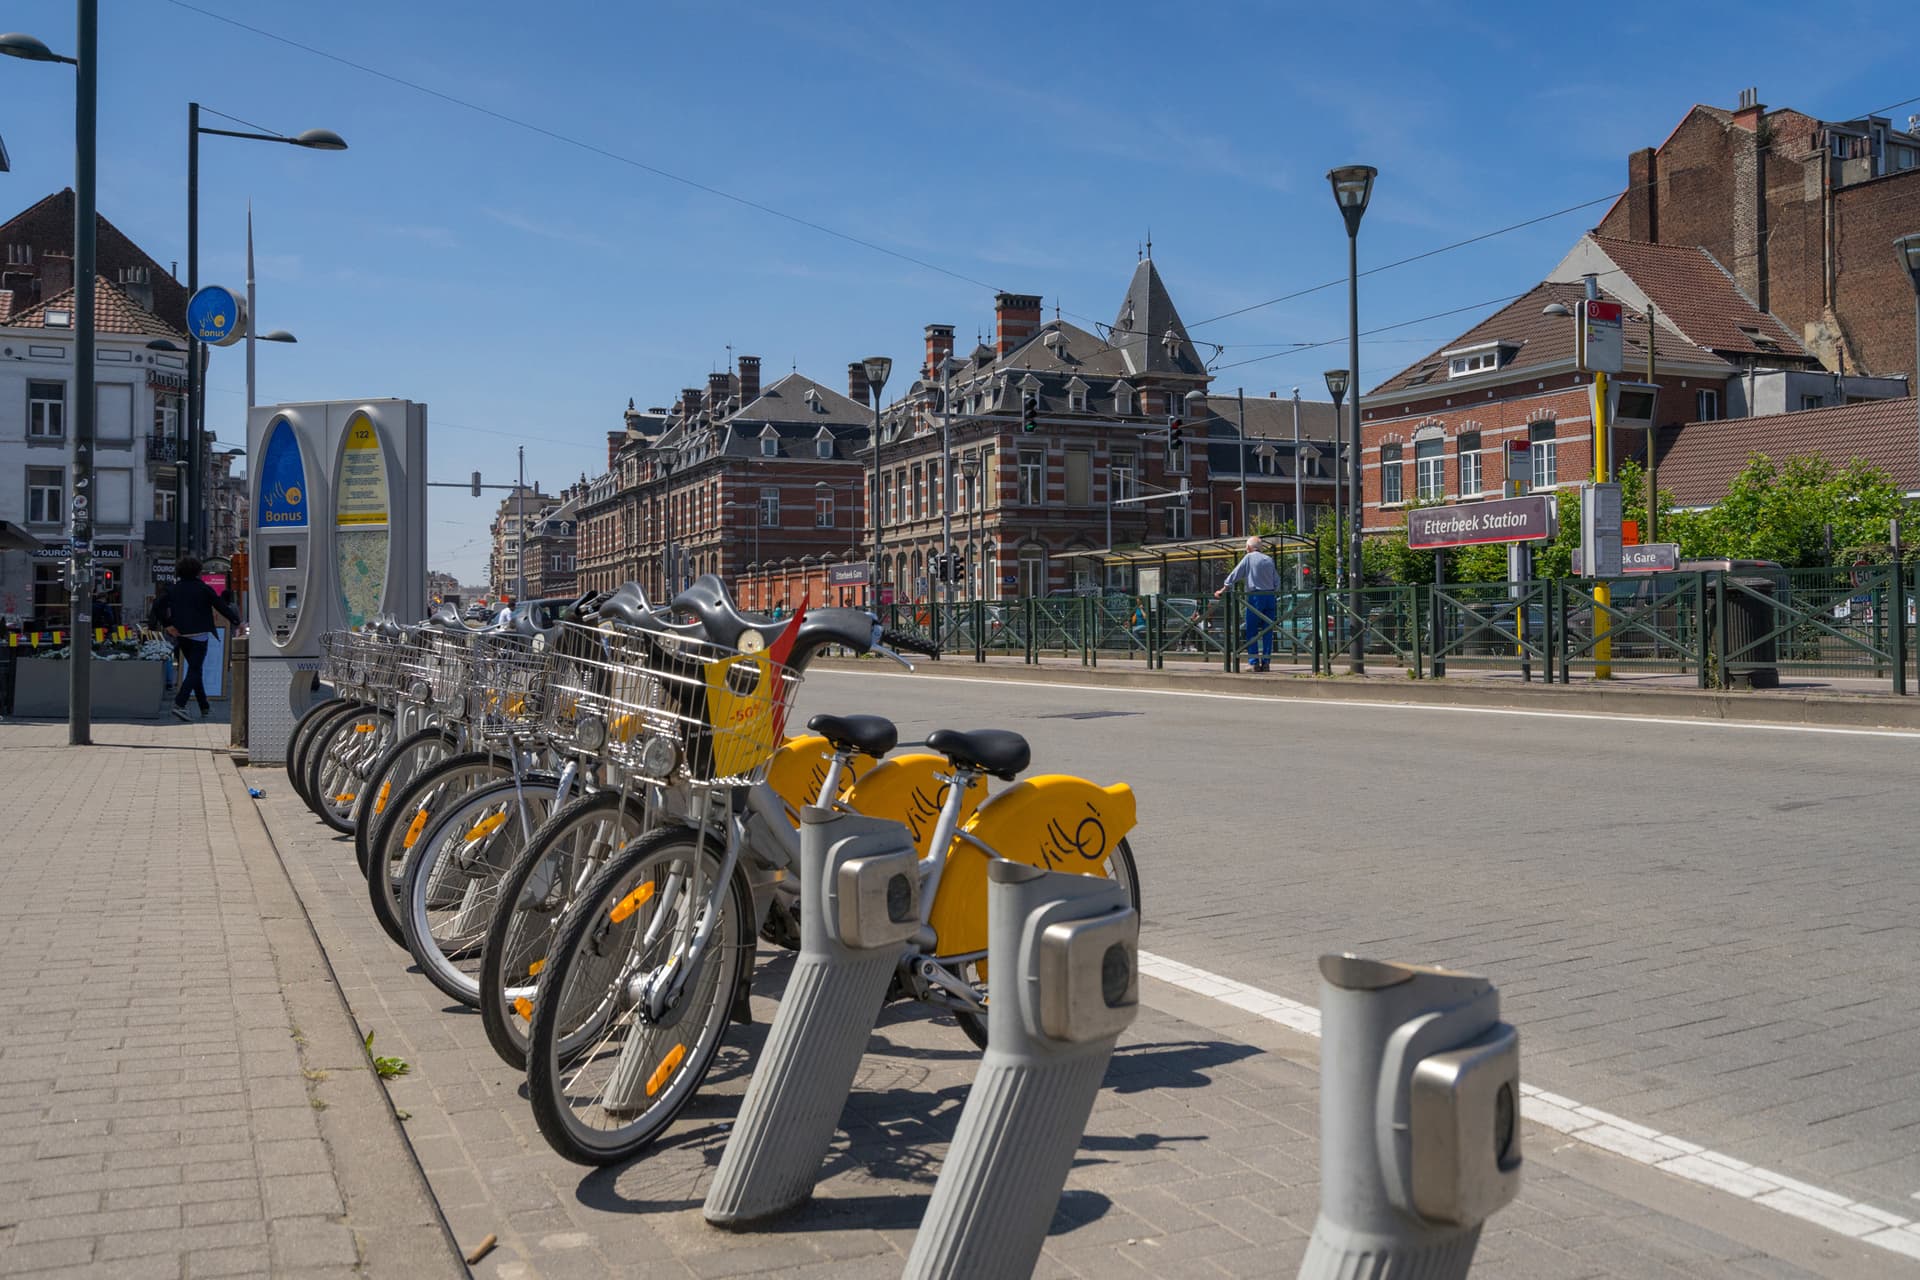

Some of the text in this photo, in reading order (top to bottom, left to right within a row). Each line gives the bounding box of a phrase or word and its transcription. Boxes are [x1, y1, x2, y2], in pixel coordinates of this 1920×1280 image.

[149, 370, 189, 388] Jupile
[355, 430, 369, 440] 122
[266, 510, 302, 522] Bonus
[1424, 511, 1528, 535] Etterbeek Station
[1633, 553, 1656, 564] Gare
[1856, 569, 1871, 585] 50
